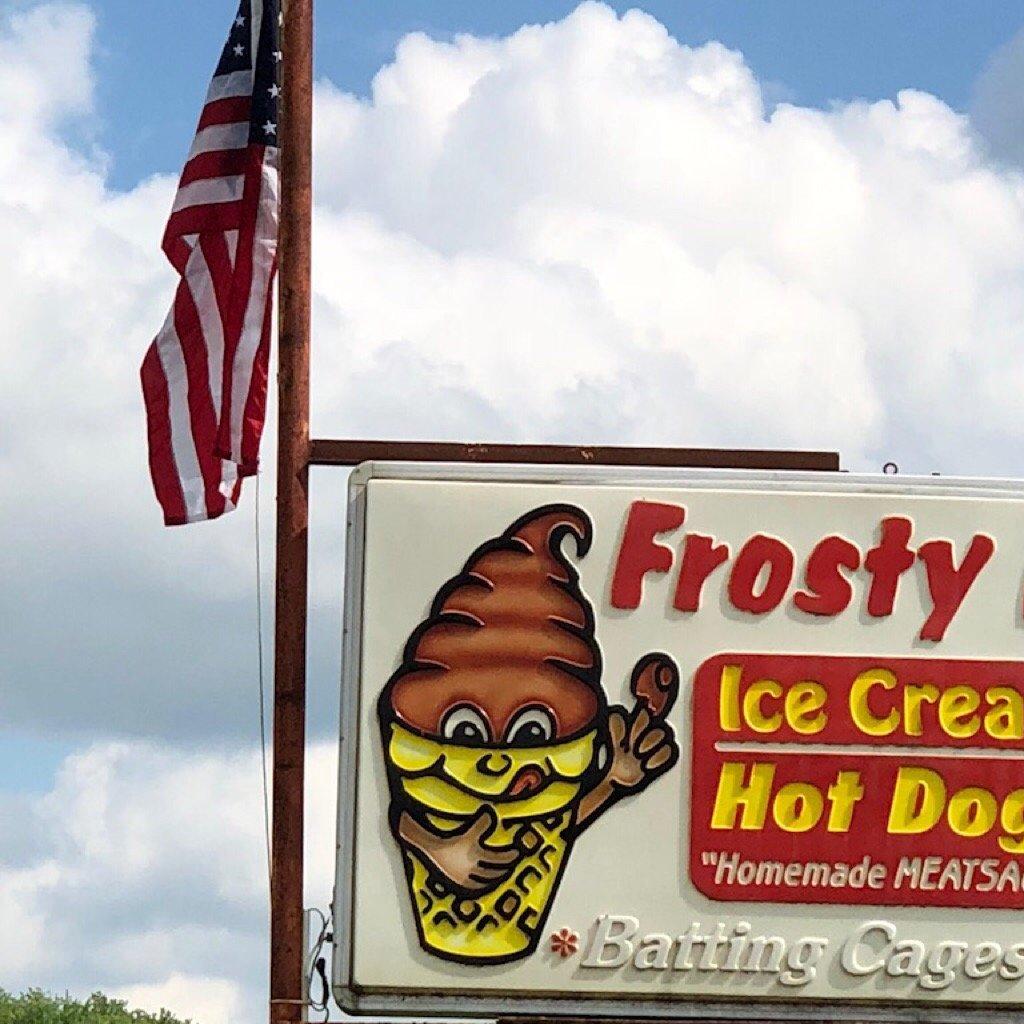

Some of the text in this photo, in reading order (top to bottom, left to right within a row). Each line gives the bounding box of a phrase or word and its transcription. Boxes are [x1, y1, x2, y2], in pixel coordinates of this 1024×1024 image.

[610, 501, 993, 642] Frosty
[719, 665, 827, 734] Ice
[710, 762, 864, 834] Hot
[701, 852, 886, 890] "Homemade
[583, 915, 826, 986] Batting
